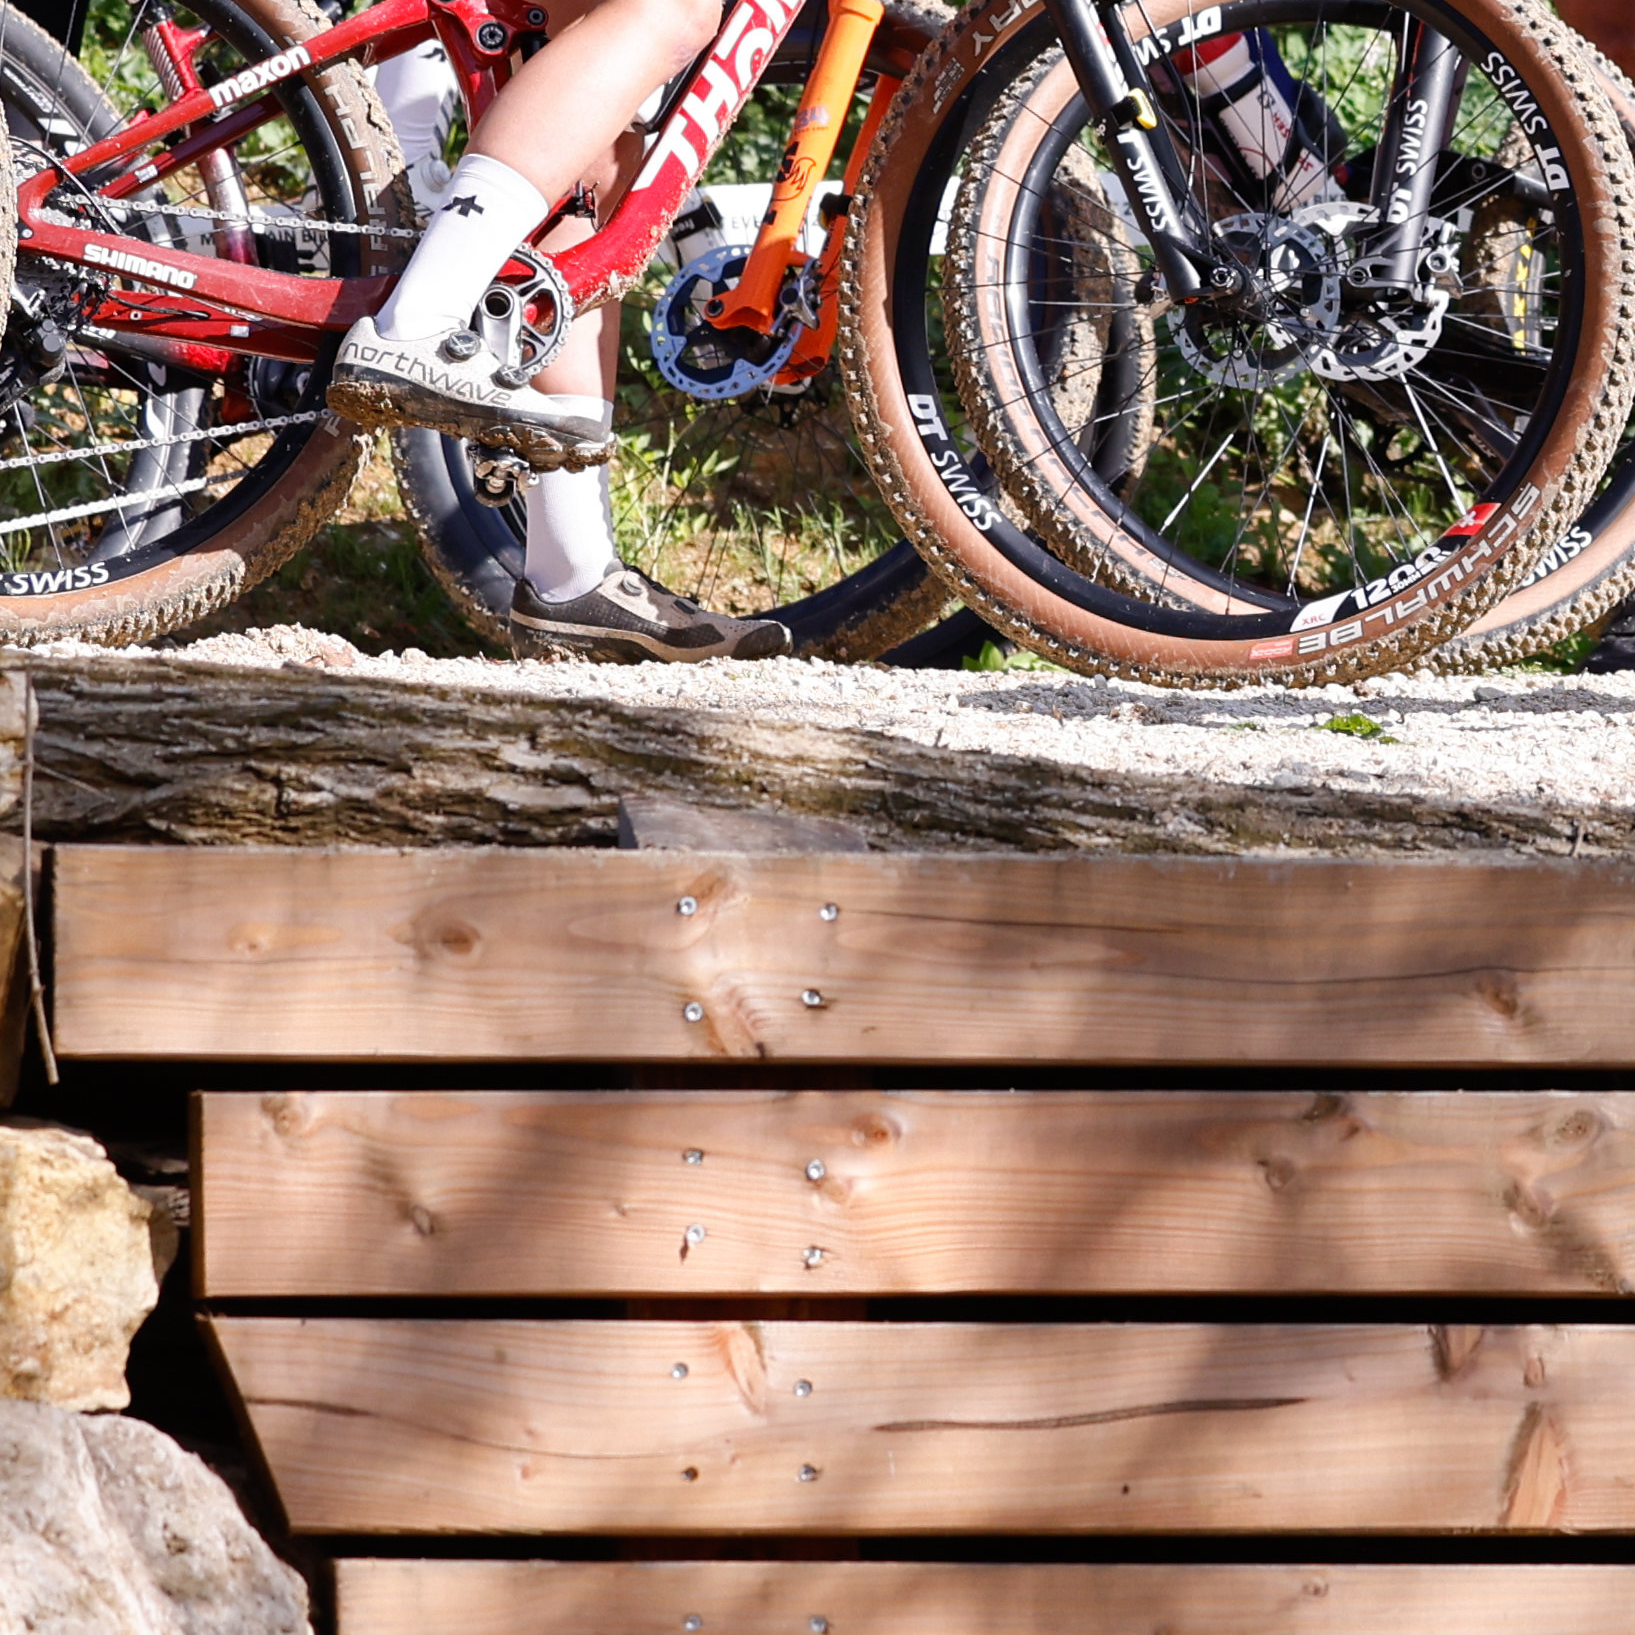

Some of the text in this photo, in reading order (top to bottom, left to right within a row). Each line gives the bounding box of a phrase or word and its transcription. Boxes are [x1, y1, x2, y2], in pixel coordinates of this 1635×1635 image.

[208, 44, 311, 108] maxon
[1480, 51, 1570, 192] DT SWISS
[1125, 155, 1178, 233] SWISS
[1386, 98, 1428, 225] DT SWISS
[84, 243, 198, 291] SHIMANO
[343, 341, 512, 407] northwave
[907, 393, 1003, 531] DT SWISS
[10, 561, 110, 596] SWISS
[1299, 481, 1542, 655] SCHWALBE
